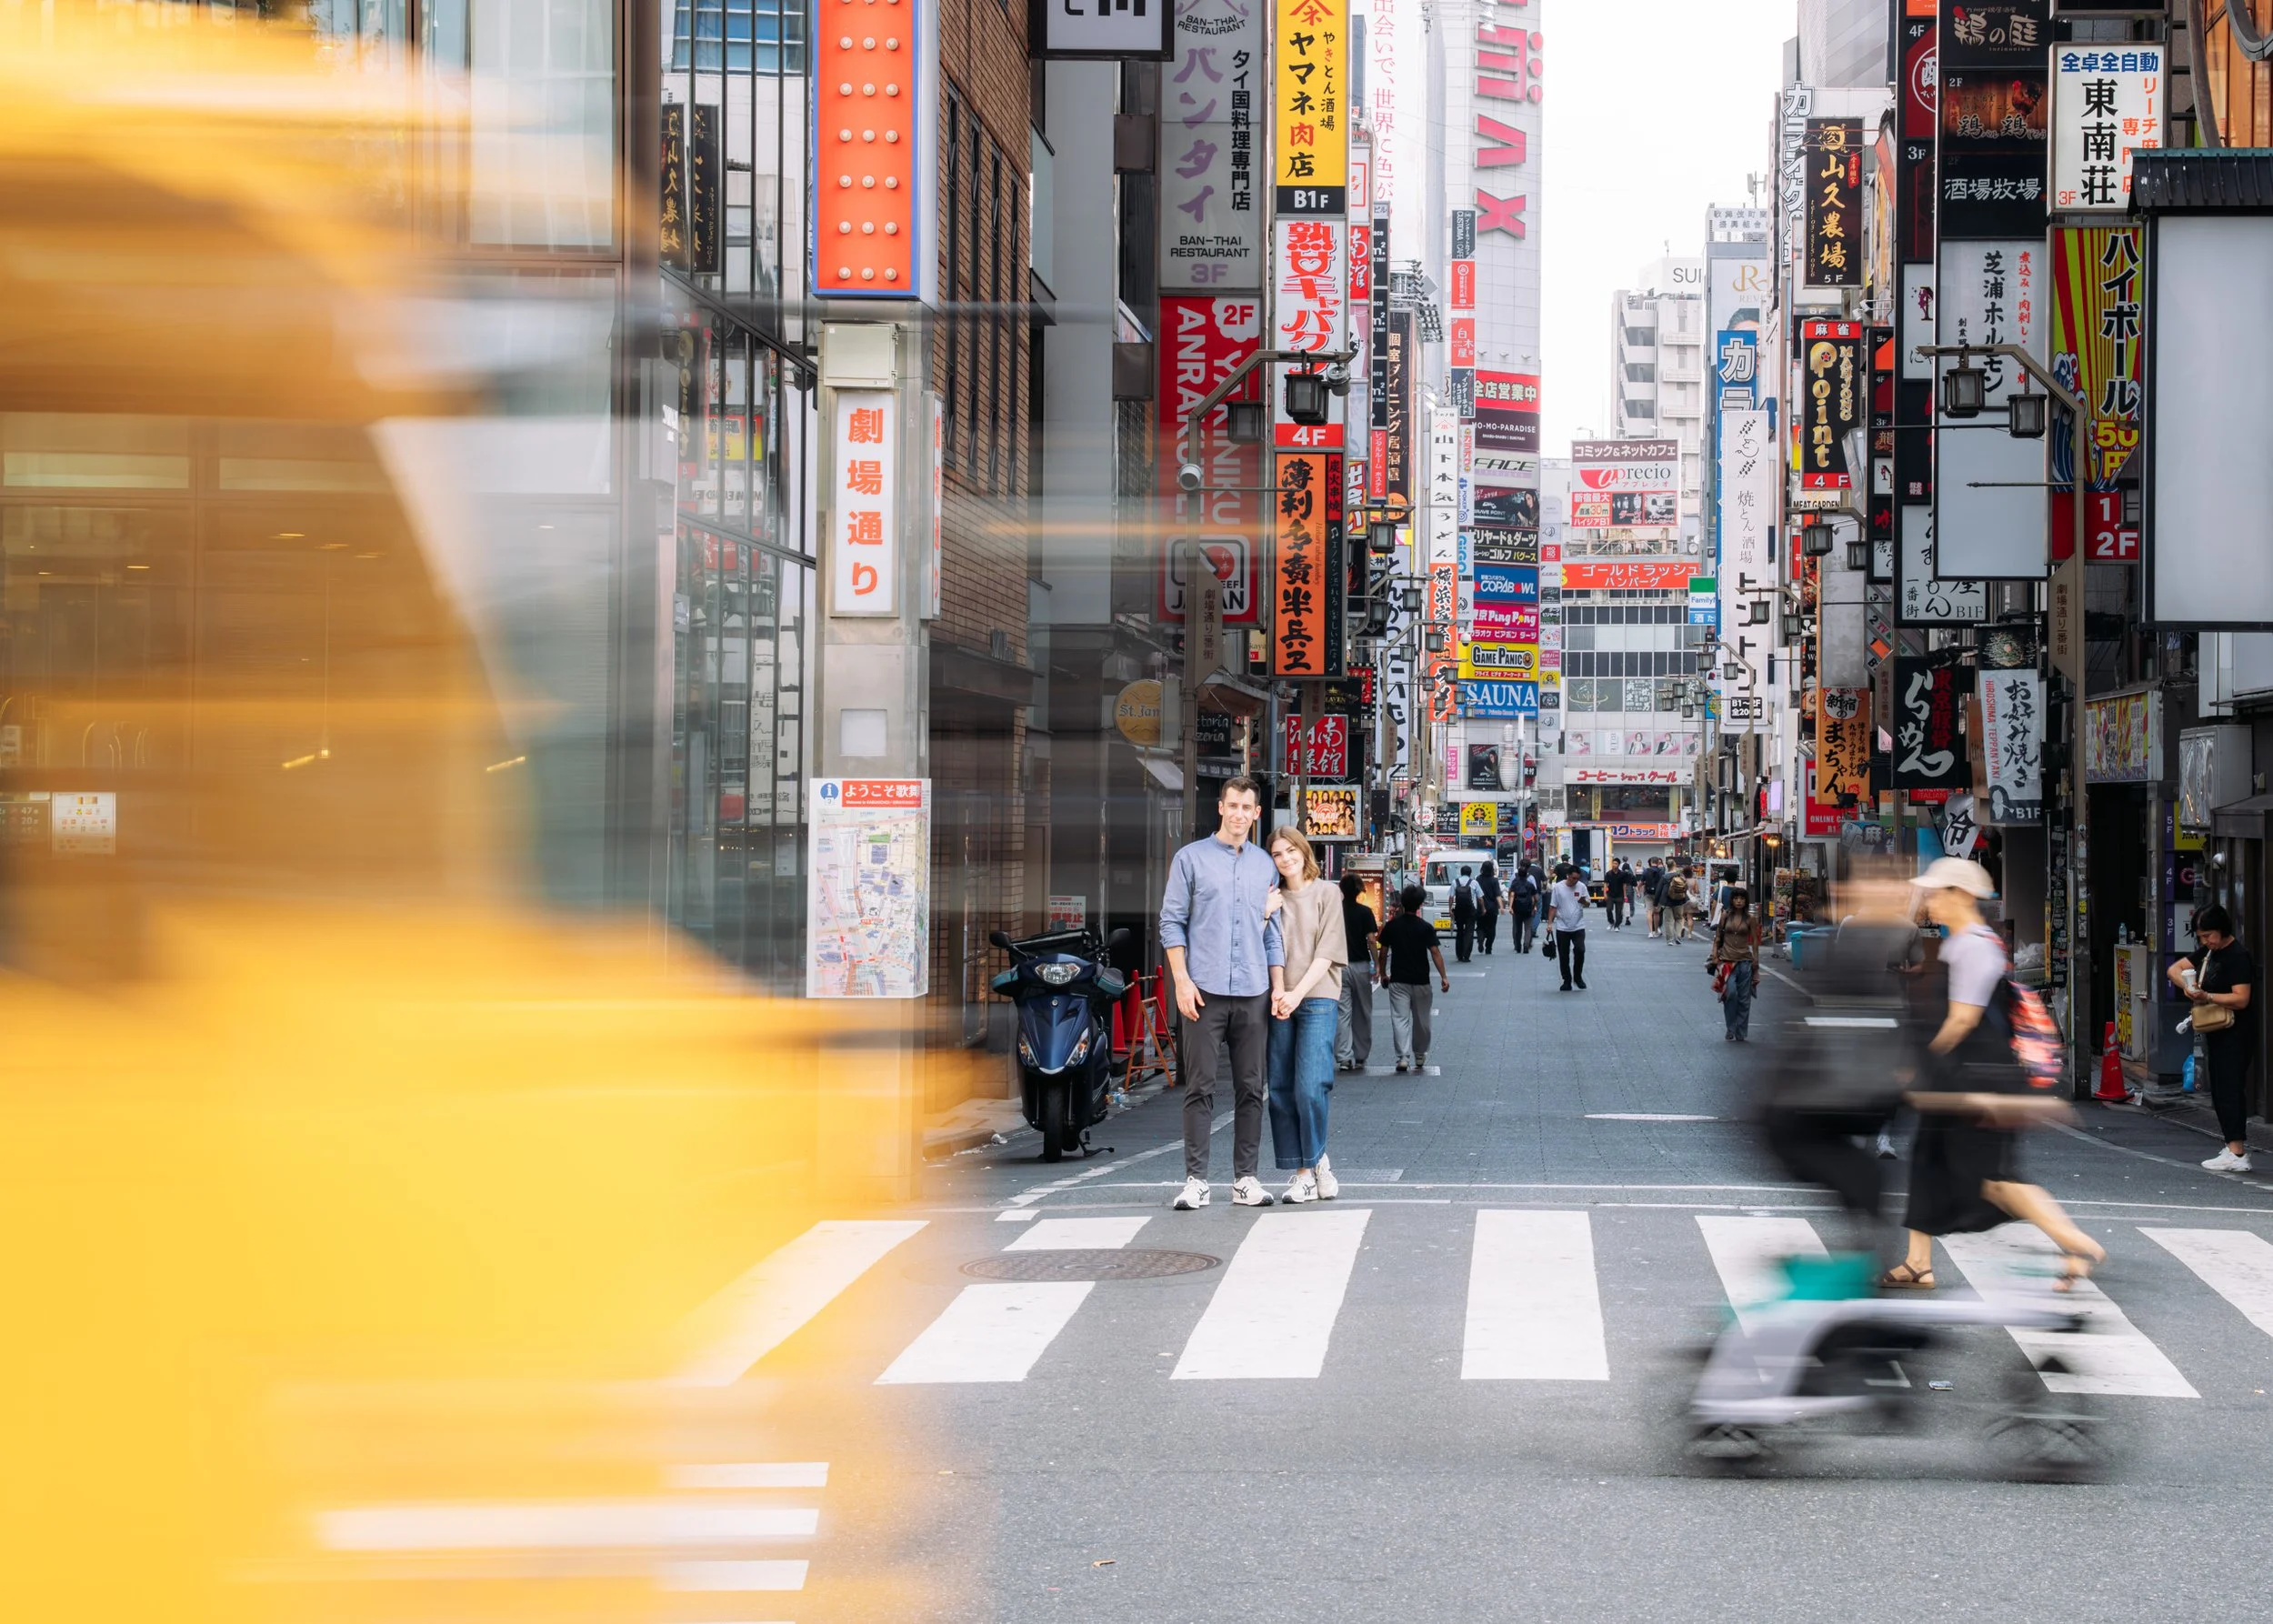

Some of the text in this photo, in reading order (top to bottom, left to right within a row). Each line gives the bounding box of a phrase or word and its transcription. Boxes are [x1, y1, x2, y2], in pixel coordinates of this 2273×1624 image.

[1177, 19, 1247, 35] RESTAURANT
[1908, 25, 1925, 37] 4F
[2060, 52, 2159, 73] 全卓全自動
[1320, 31, 1336, 132] やきとん酒場
[1948, 77, 1963, 87] 2F
[1286, 32, 1316, 178] ヤマネ肉店
[1173, 47, 1224, 224] バンタイ
[1231, 49, 1251, 211] タイ国料理専門店
[2080, 78, 2118, 206] 東南荘
[1908, 146, 1926, 160] 3F
[1294, 190, 1329, 209] B1F
[1945, 177, 2042, 201] 酒場牧場
[2058, 189, 2077, 206] 3F
[1819, 153, 1847, 269] 山久農場
[1179, 236, 1242, 246] BAN-THAI
[1170, 247, 1250, 258] RESTAURANT
[1191, 263, 1228, 284] 3F
[1223, 305, 1254, 326] 2F
[2099, 232, 2142, 416] ハイボール
[1815, 323, 1850, 336] 麻雀
[1475, 380, 1537, 403] 全店営業中
[1839, 346, 1853, 422] MAHJONG
[1809, 341, 1837, 468] Point
[1876, 418, 1887, 426] 3F
[1292, 426, 1326, 446] 4F
[1574, 444, 1677, 457] コミック&ネットカフェ
[1597, 463, 1671, 487] aprecio
[1327, 460, 1341, 512] 炭火串焼
[846, 407, 884, 596] 劇場通り
[1793, 500, 1811, 508] MEAT
[2099, 497, 2111, 523] 1
[1489, 548, 1512, 561] ゴルフ
[2097, 532, 2138, 556] 2F
[1581, 564, 1699, 577] ゴールドラッシュ
[1605, 576, 1660, 587] ハンバーグ
[1488, 610, 1510, 626] Ping
[1694, 614, 1704, 623] 酒
[1956, 606, 1984, 618] B1F
[2057, 583, 2068, 656] 劇場通り一番街
[1203, 589, 1216, 660] 劇場通り一番街
[1473, 646, 1497, 665] GAME
[1497, 647, 1523, 666] PANIC
[1467, 683, 1537, 707] SAUNA
[1985, 680, 2000, 779] HIROSHIMA TEPPANYAKI
[2001, 678, 2039, 788] お好み焼き
[1577, 770, 1617, 782] コーヒー
[1647, 770, 1677, 783] クール
[1810, 815, 1835, 823] ONLINE
[2016, 807, 2041, 819] B1F
